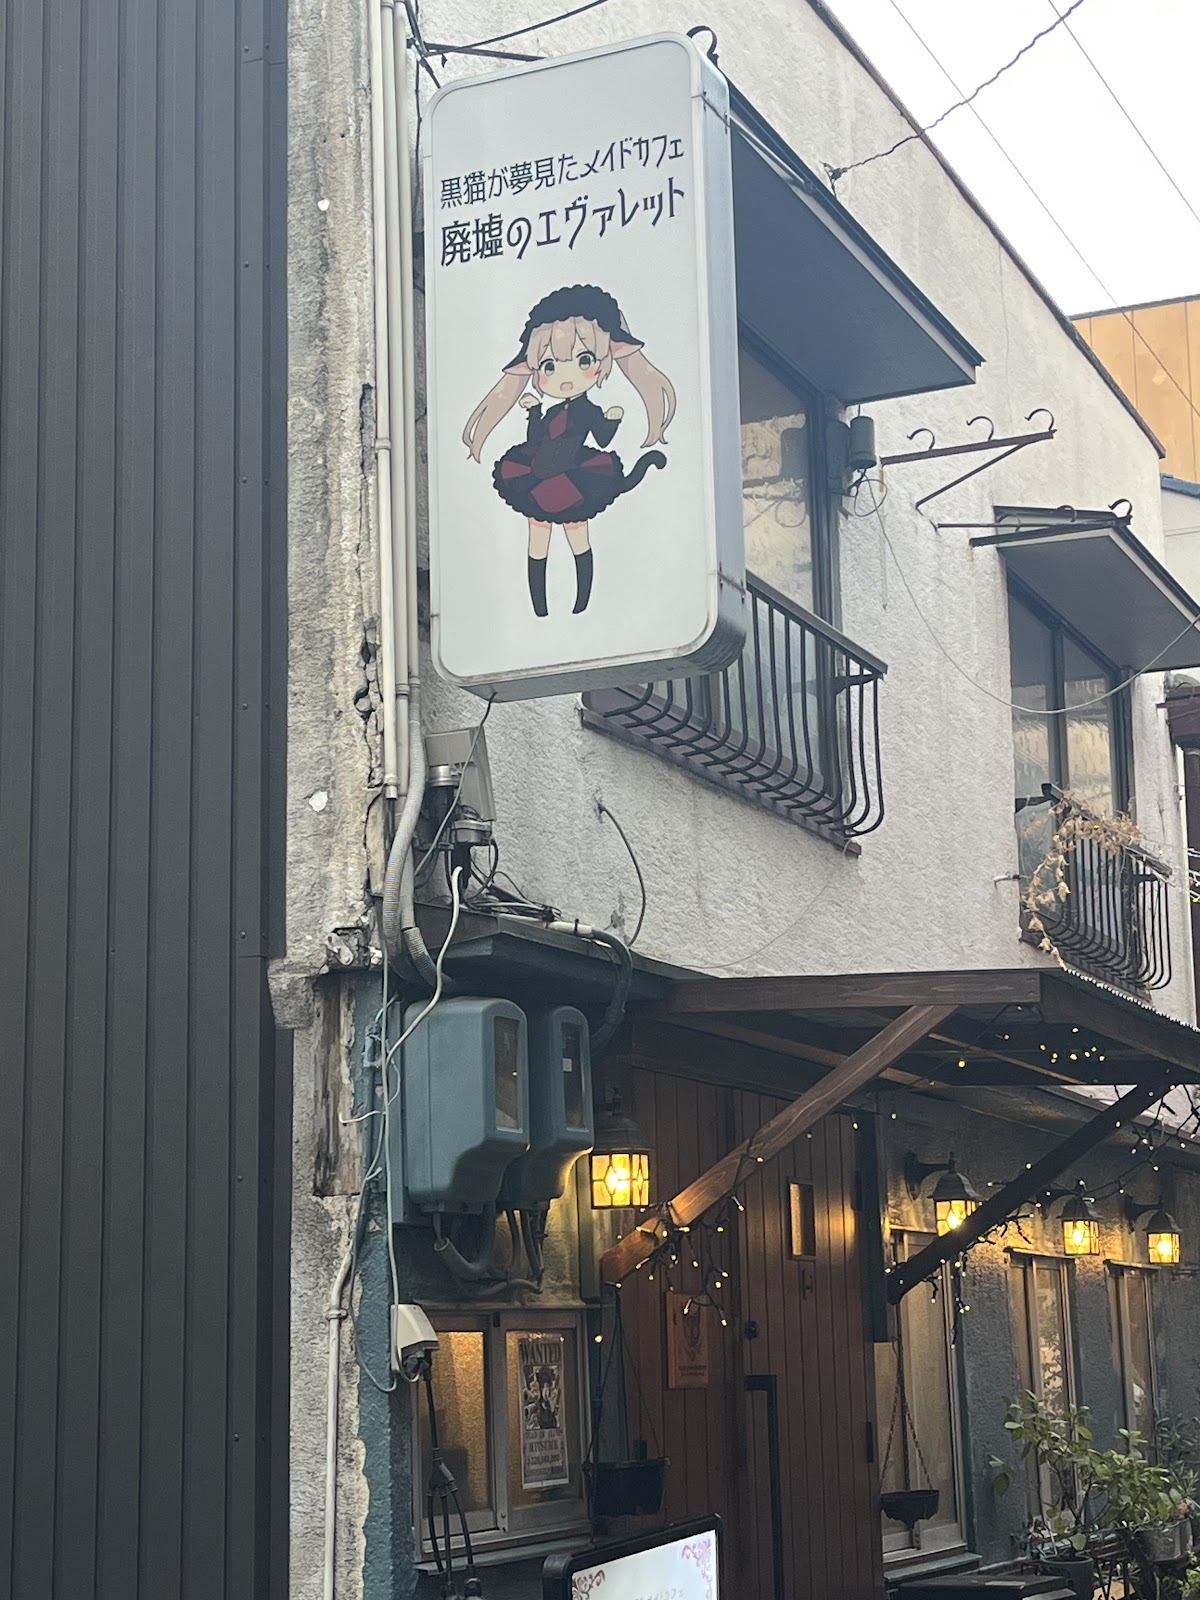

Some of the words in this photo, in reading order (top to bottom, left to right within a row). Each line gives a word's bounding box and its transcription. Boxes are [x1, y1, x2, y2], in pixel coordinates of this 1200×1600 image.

[440, 134, 685, 210] 黒猫が夢見たメイドカフェ
[440, 176, 686, 267] 廃墟のエヴァレット
[519, 1342, 561, 1365] WANTED
